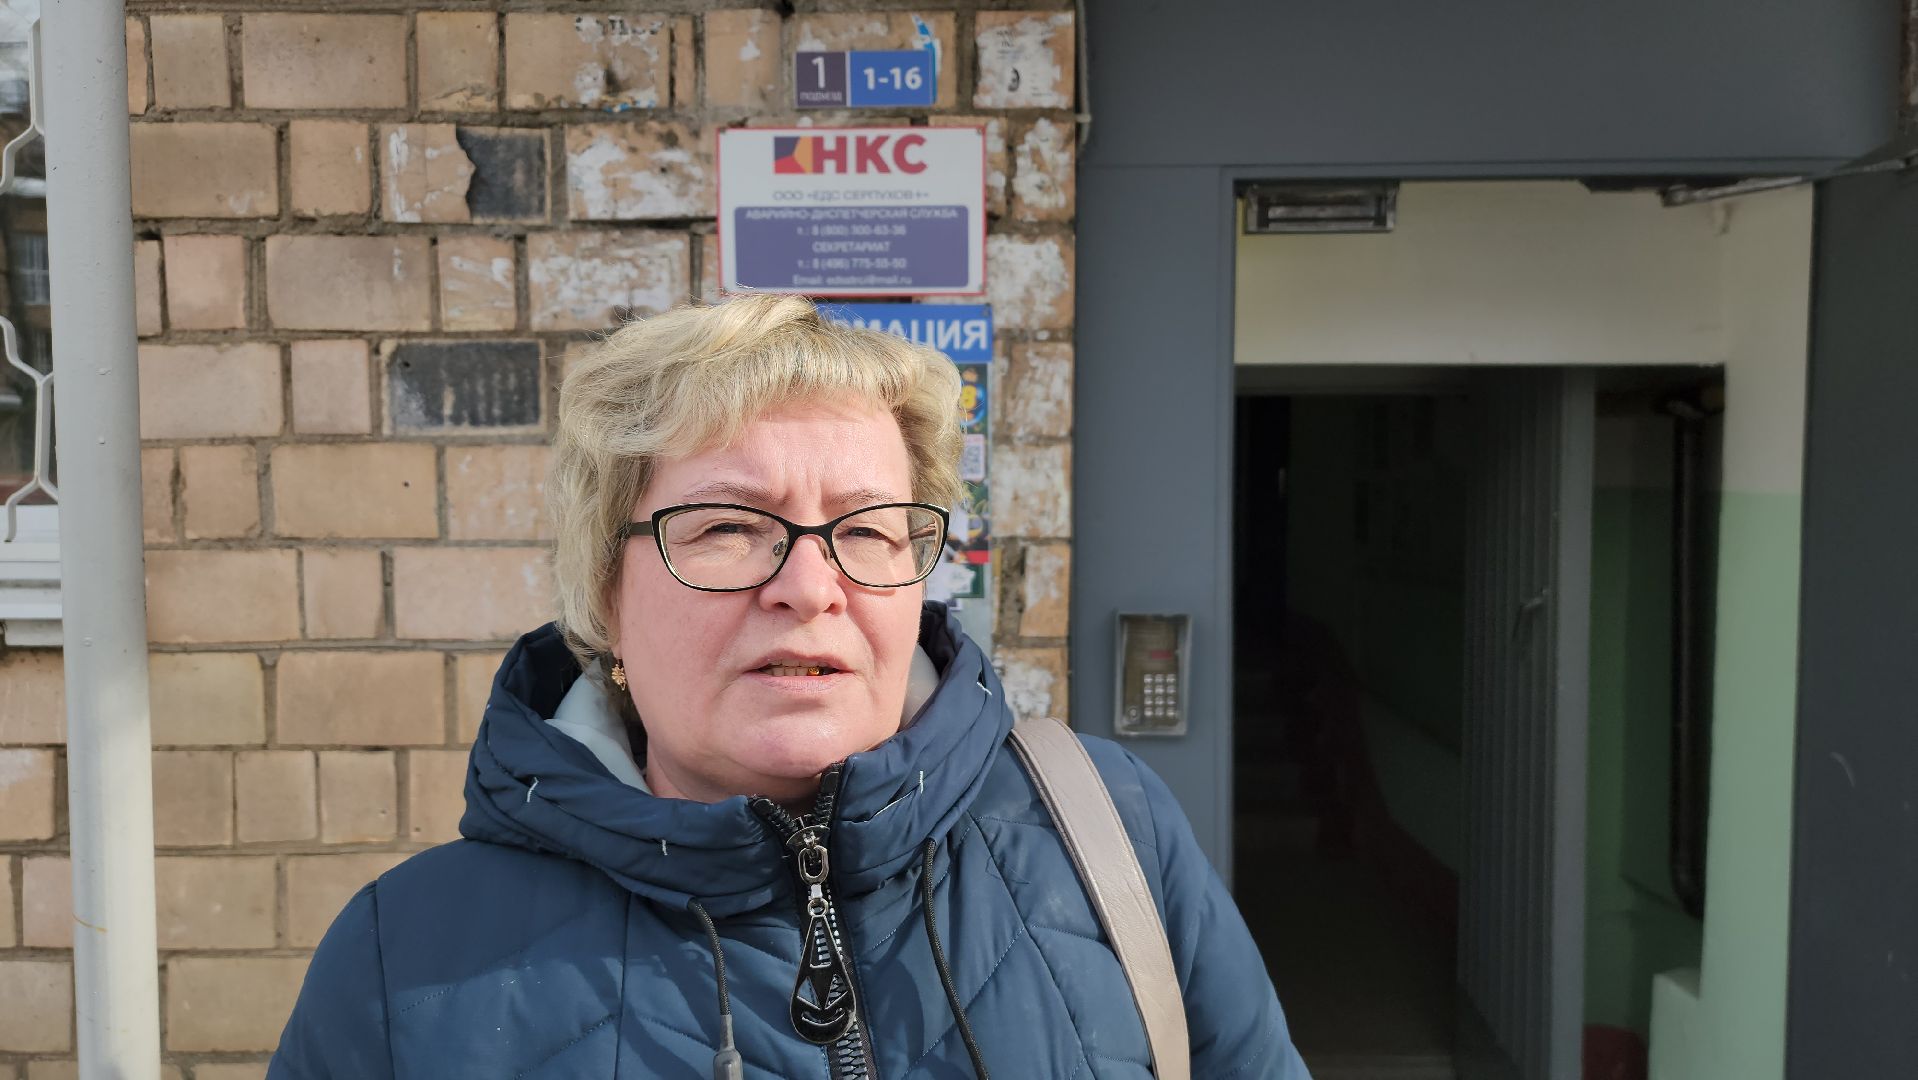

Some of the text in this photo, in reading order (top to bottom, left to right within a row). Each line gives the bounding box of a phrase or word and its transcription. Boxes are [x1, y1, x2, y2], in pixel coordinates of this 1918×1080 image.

[811, 56, 826, 89] 1
[863, 66, 923, 91] 1-16
[812, 134, 928, 175] НКС
[773, 190, 804, 201] ООО
[909, 207, 959, 219] СЛУЖБА
[811, 224, 820, 236] 8
[811, 241, 891, 252] СЕКРЕТАРИАТ
[812, 258, 820, 270] 8
